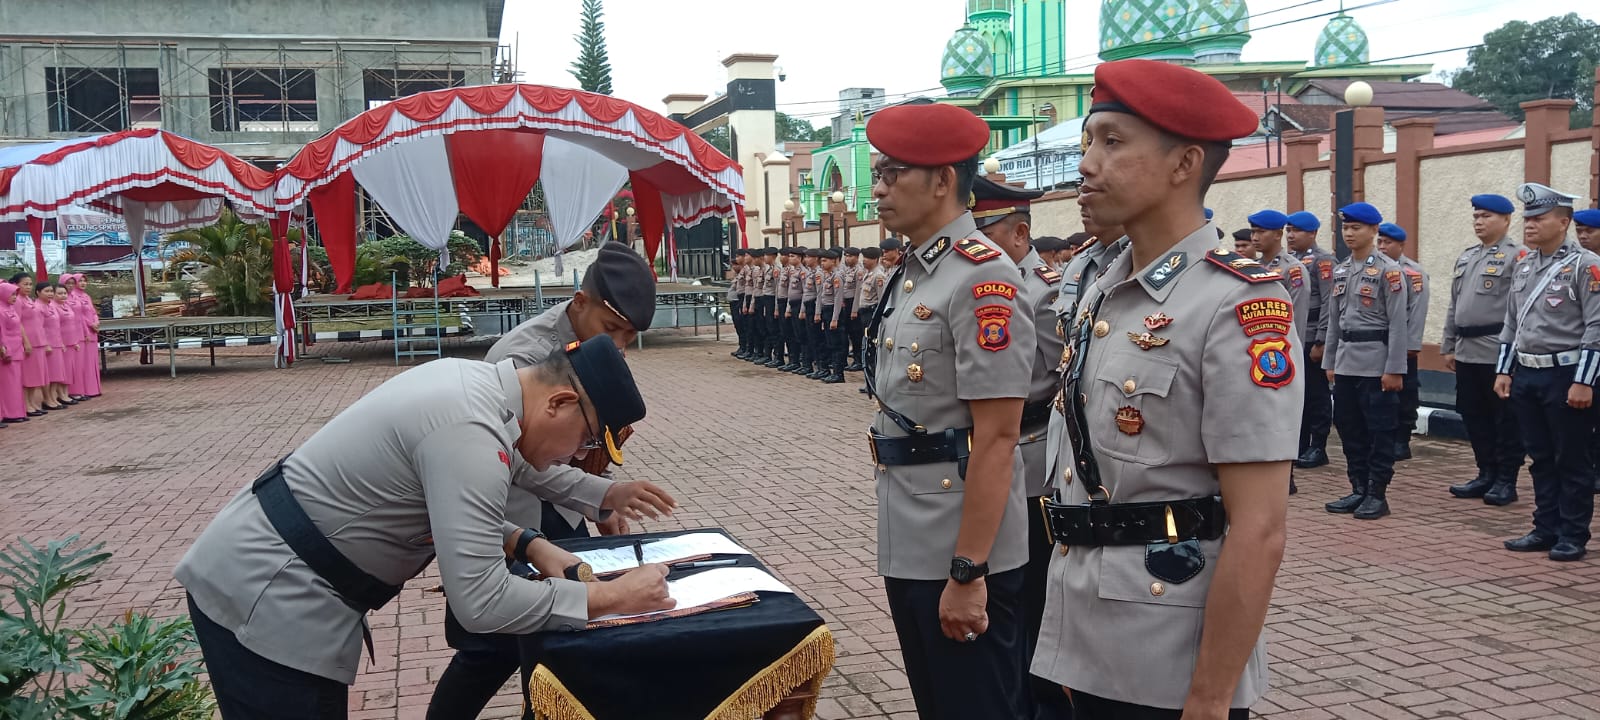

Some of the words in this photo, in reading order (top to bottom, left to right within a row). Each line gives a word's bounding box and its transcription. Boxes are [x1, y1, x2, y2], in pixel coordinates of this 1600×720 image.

[1361, 276, 1379, 285] POLRI
[976, 284, 1012, 297] POLDA
[1242, 301, 1287, 313] POLRES
[1242, 309, 1265, 321] KUTAI
[1265, 309, 1289, 318] BARAT
